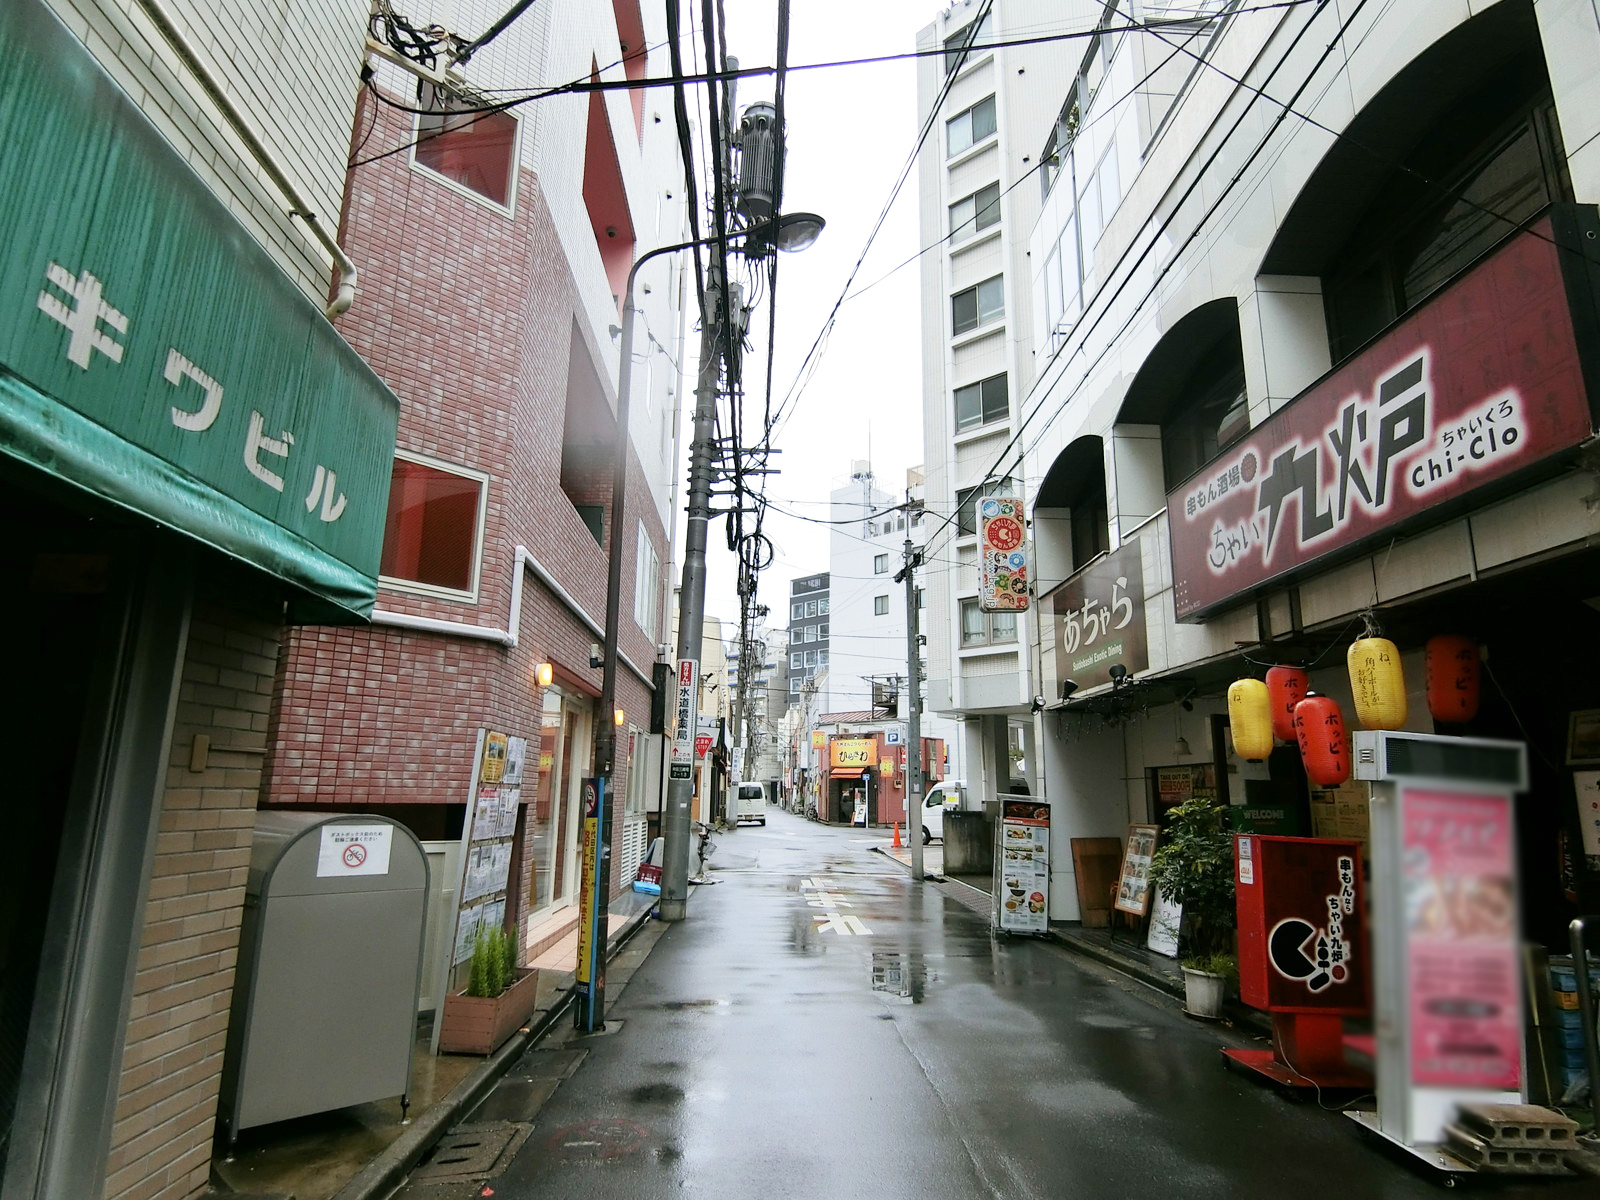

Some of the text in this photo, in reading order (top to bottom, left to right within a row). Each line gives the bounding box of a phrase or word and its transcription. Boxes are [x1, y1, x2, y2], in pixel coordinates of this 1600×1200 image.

[38, 260, 347, 523] キワビル
[1442, 399, 1513, 449] ちゃいくろ
[1186, 464, 1241, 516] 串もん酒場
[985, 550, 998, 609] www.bcg.jp
[1063, 576, 1134, 654] あちゃら
[1107, 643, 1123, 657] Dining
[677, 687, 690, 741] 水道橋薬局
[1243, 809, 1285, 819] WELCOME
[800, 877, 874, 936] 止まれ
[1328, 897, 1343, 963] ちゃい九炉
